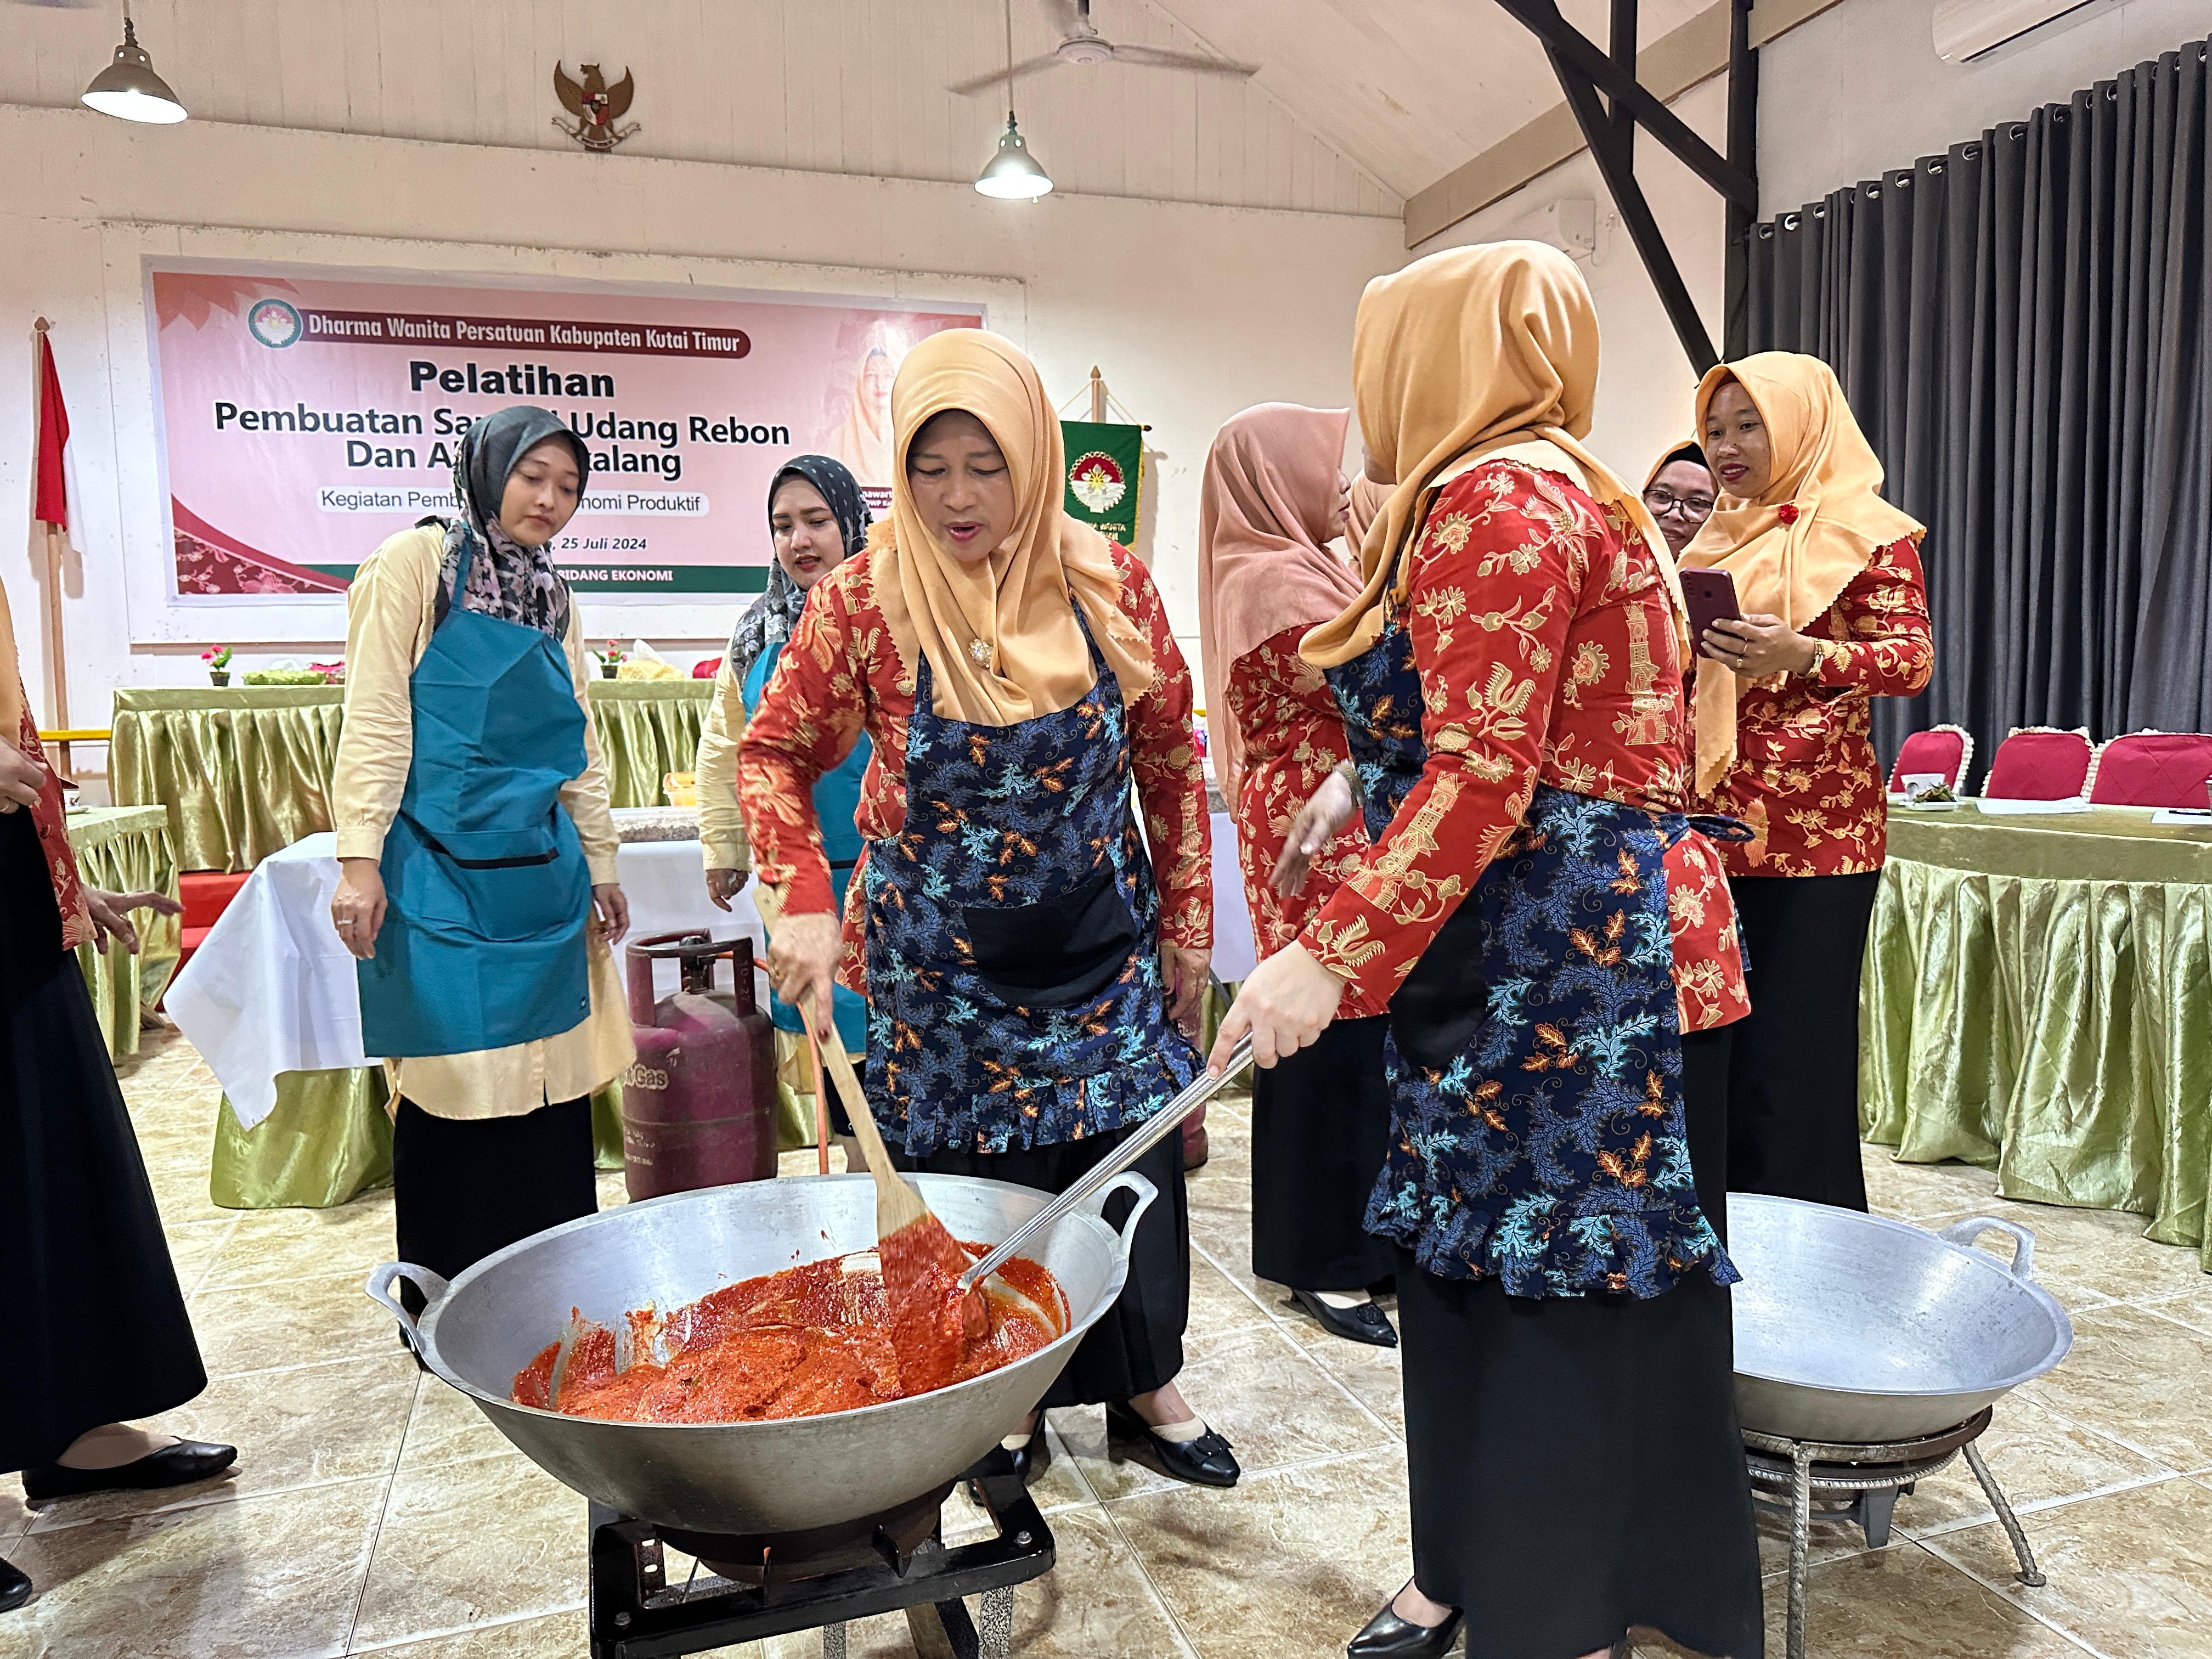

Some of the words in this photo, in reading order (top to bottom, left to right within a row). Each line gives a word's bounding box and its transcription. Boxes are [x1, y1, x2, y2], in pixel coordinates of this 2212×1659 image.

[309, 314, 382, 337] Dharma
[386, 317, 451, 340] Wanita
[456, 320, 545, 343] Persatuan
[550, 324, 641, 349] Kabupaten
[646, 328, 688, 349] Kutai
[692, 331, 740, 352] Timur
[409, 360, 614, 398] Pelatihan
[215, 402, 422, 435] Pembuatan
[571, 411, 678, 449] Udang
[689, 416, 789, 445] Rebon
[346, 439, 416, 468] Dan
[321, 490, 402, 510] Kegiatan
[627, 495, 701, 511] Produktif
[561, 538, 578, 549] 25
[583, 538, 608, 550] Juli
[612, 538, 647, 550] 2024
[557, 569, 608, 581] BIDANG
[611, 569, 673, 582] EKONOMI
